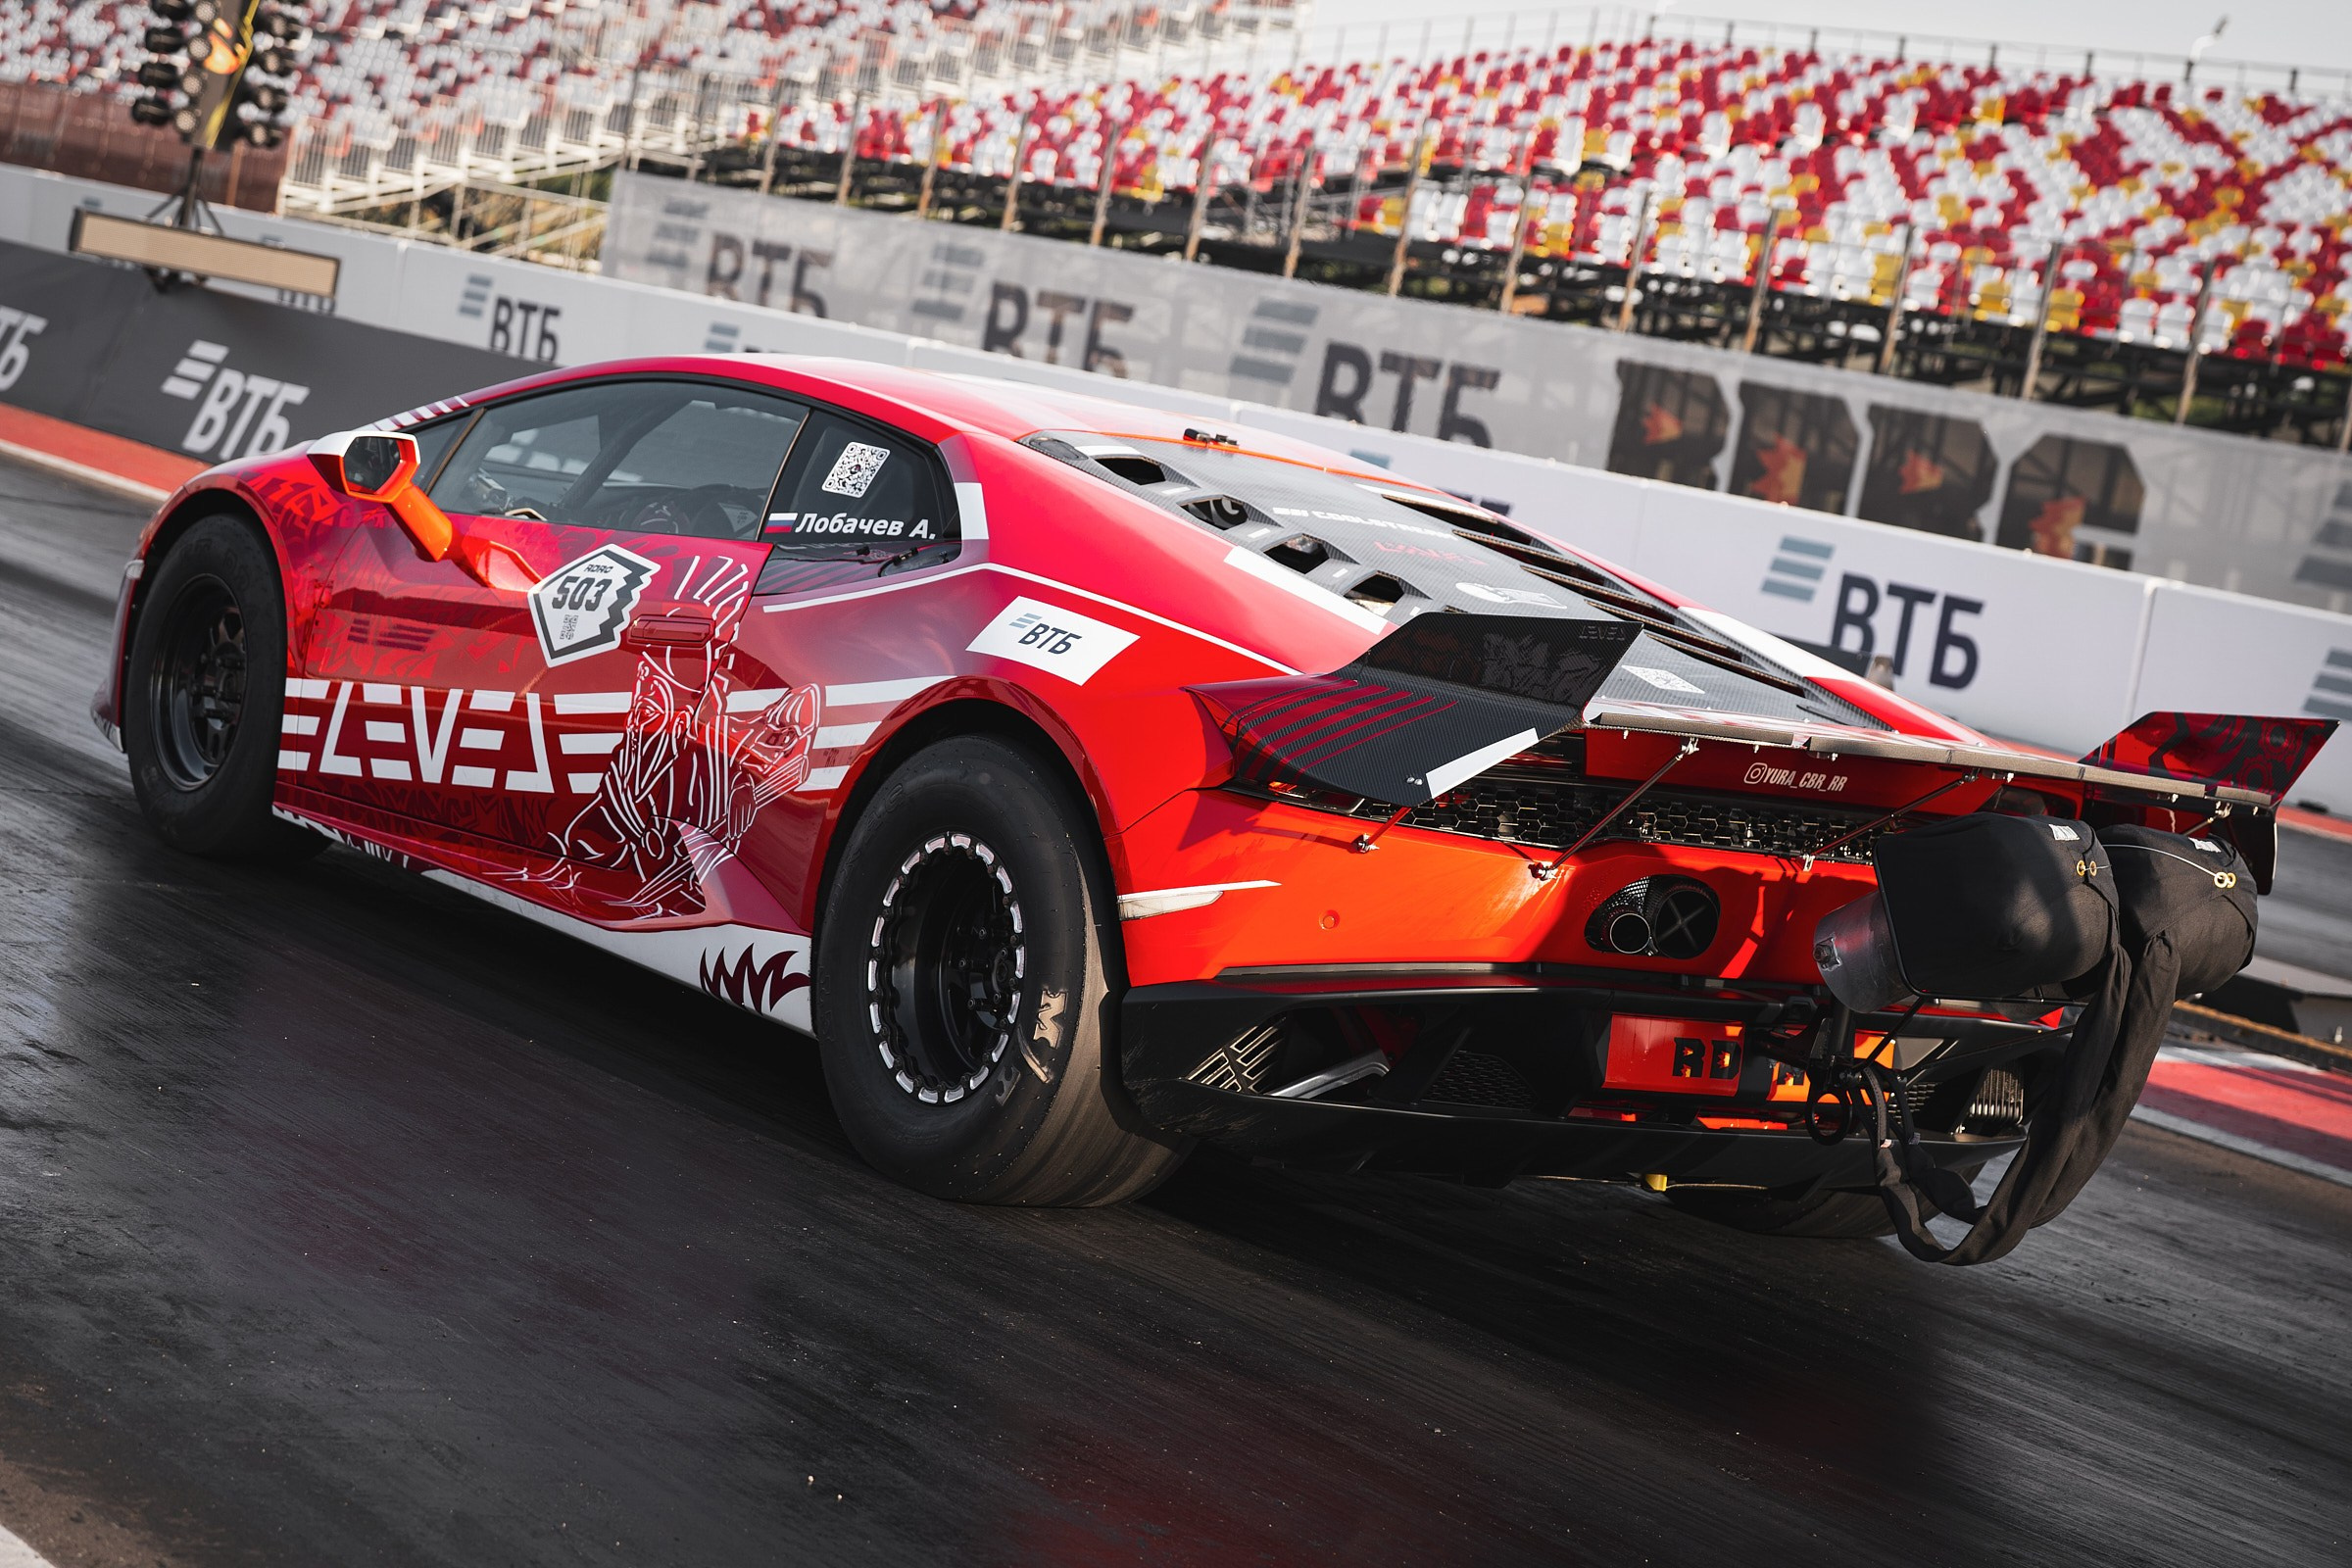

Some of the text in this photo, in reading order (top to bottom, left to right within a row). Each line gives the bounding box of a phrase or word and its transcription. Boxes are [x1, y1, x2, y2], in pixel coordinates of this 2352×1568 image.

[491, 296, 560, 362] ВТБ
[0, 305, 48, 392] ТБ
[182, 368, 311, 461] ВТБ
[795, 513, 936, 540] Лобачев А.
[583, 564, 614, 574] RDRC
[551, 575, 613, 612] 503
[1017, 622, 1083, 655] ВТБ
[1831, 572, 1984, 690] ВТБ
[1763, 767, 1848, 792] YURA_CBR_RR
